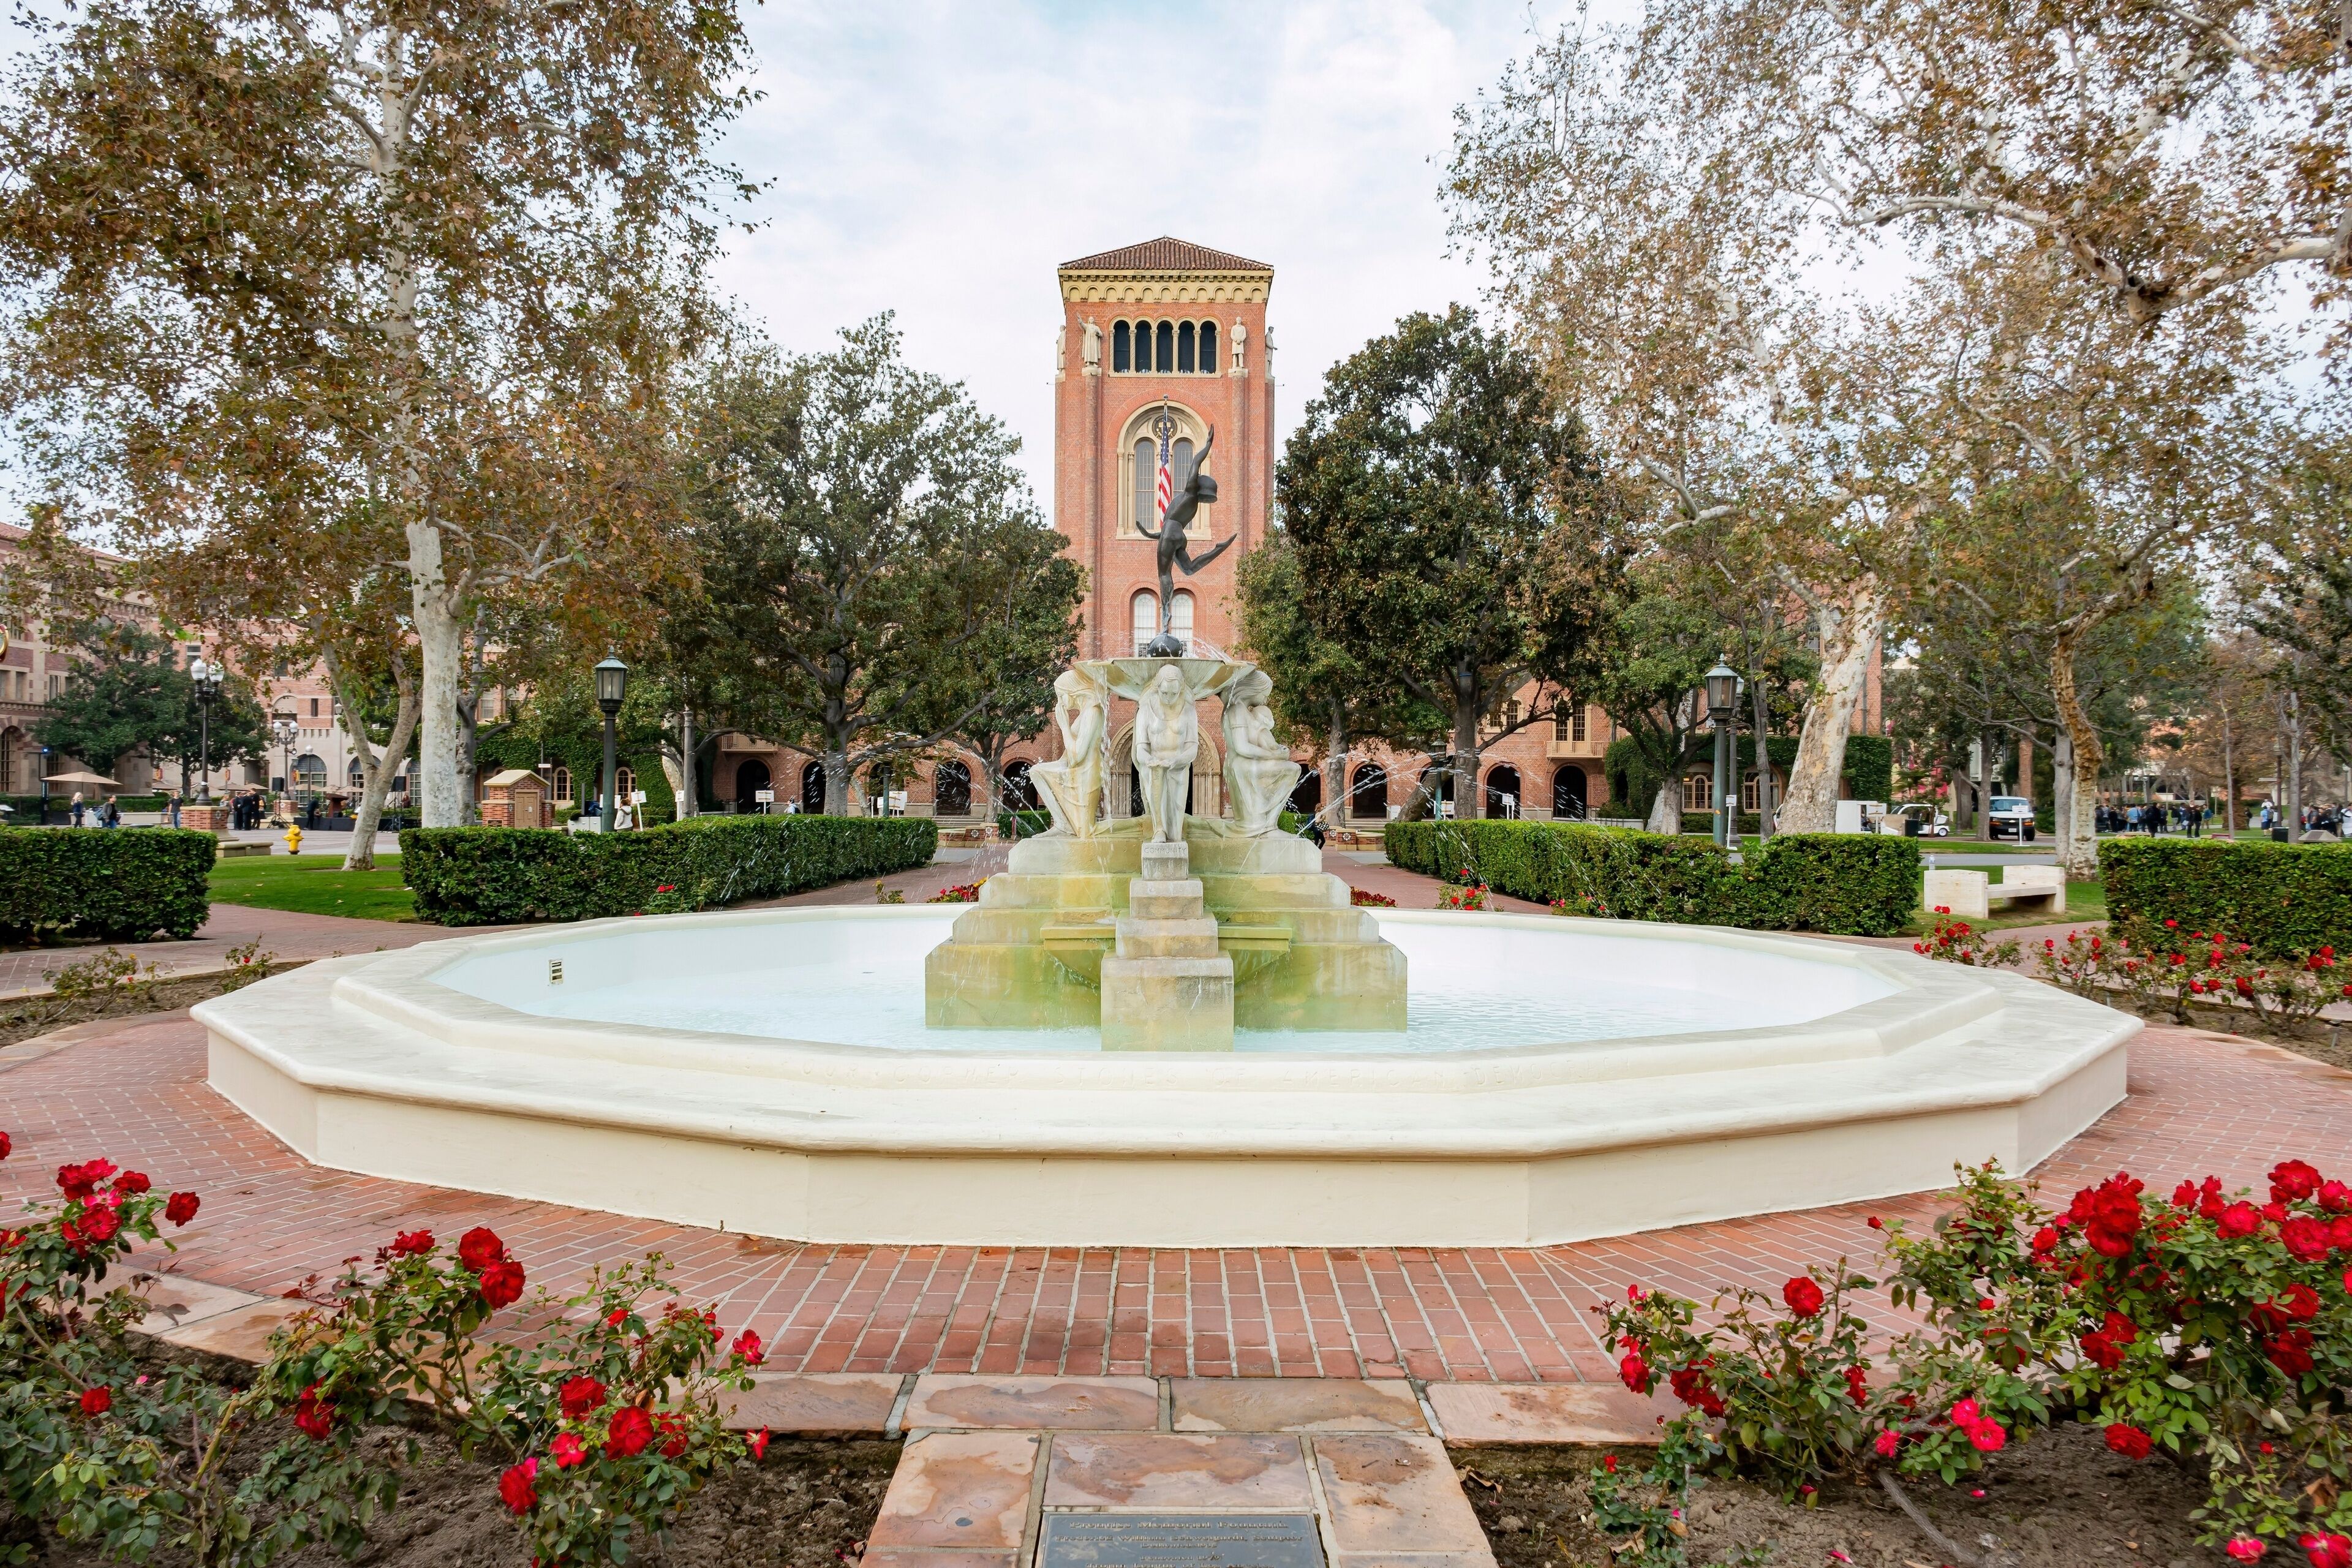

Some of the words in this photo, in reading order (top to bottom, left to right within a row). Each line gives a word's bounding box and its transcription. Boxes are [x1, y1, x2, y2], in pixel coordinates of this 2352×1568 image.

[893, 1065, 1024, 1085] CORNER
[1054, 1066, 1178, 1087] STONES
[1281, 1068, 1447, 1088] AMERICAN
[1472, 1057, 1630, 1085] DEMOCRACY
